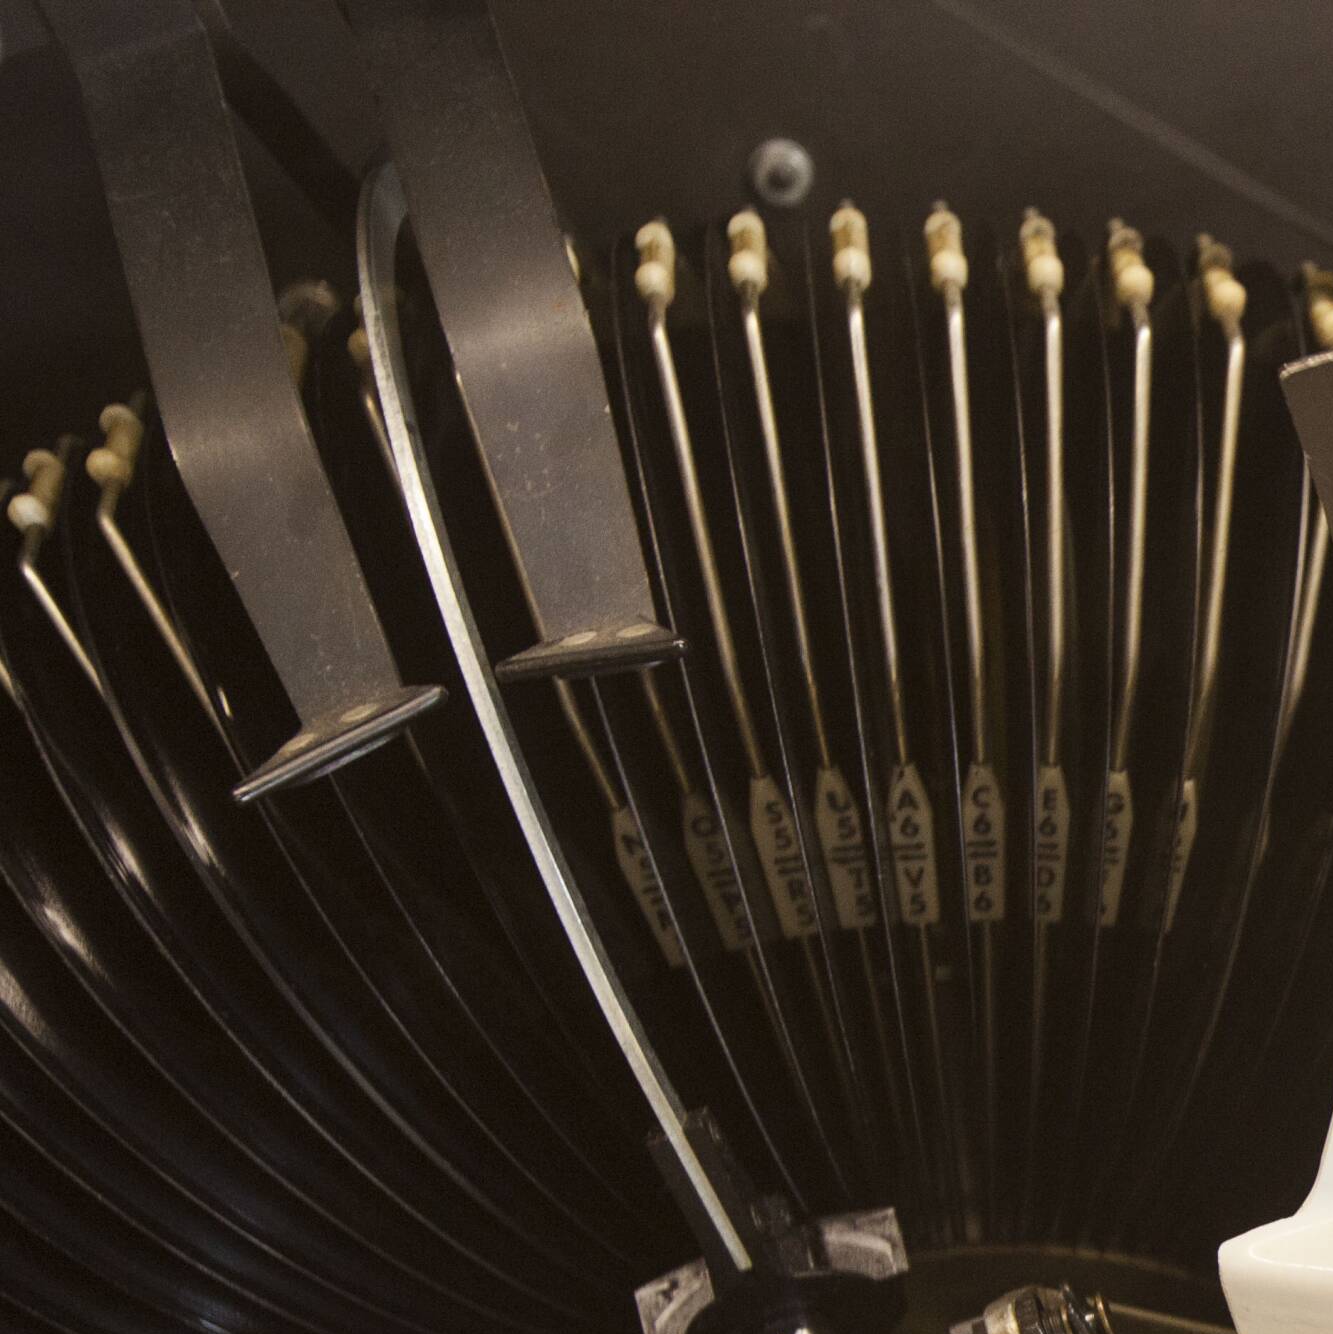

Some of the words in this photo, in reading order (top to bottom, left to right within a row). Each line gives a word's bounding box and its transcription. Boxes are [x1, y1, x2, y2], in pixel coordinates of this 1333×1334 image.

[896, 788, 920, 837] A6
[972, 785, 992, 835] C6
[903, 866, 926, 916] V5
[973, 865, 993, 912] B6
